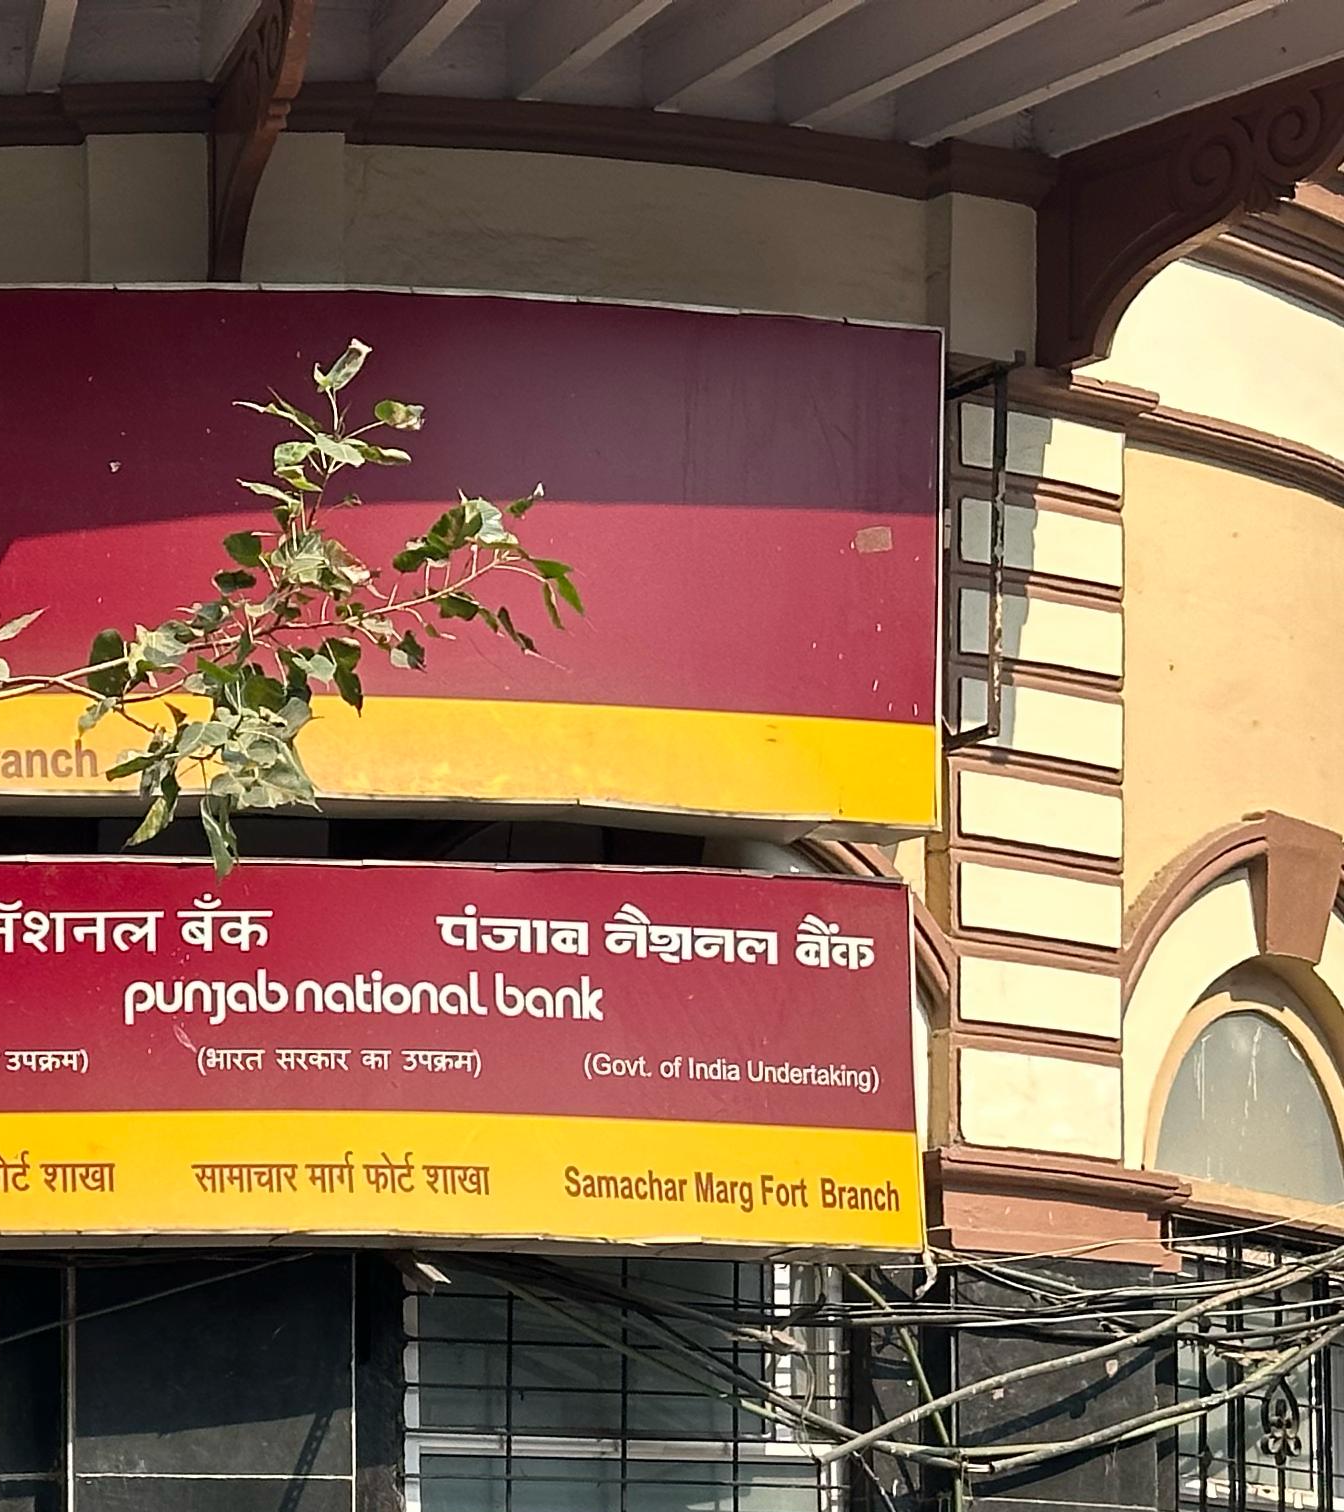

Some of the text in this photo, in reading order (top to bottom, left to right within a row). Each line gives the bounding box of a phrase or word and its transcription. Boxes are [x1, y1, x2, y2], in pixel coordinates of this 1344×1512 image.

[178, 893, 272, 953] बँक
[437, 903, 876, 970] पंजाब नैशनल बैंक
[123, 968, 605, 1026] punjab national bank
[5, 1046, 90, 1076] उपक्रम)
[196, 1047, 483, 1077] (भारत सरकार का उपक्रम)
[583, 1053, 880, 1093] (Govt. of India Undertaking)
[40, 1162, 116, 1193] शाखा
[192, 1150, 491, 1197] सामाचार मार्ग फोर्ट शाखा
[565, 1166, 901, 1213] Samachar Marg Fort Branch
